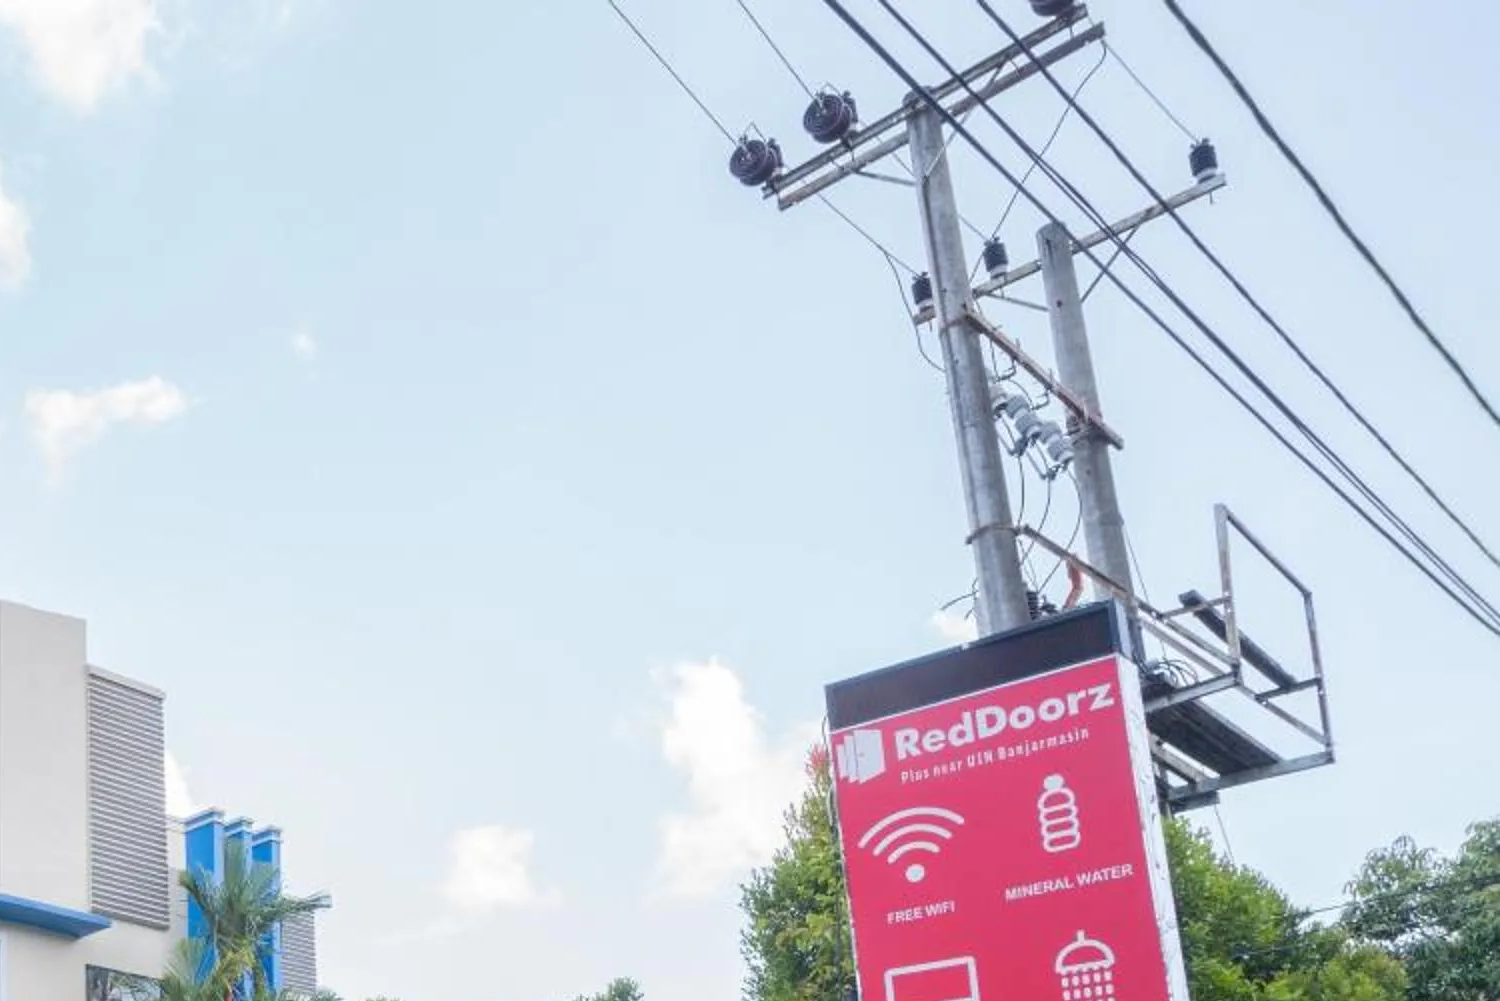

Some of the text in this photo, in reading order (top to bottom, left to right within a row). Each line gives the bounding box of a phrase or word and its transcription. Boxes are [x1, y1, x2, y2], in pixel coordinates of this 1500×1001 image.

[894, 683, 1115, 761] RedDoorz
[900, 767, 929, 784] Plus
[933, 759, 963, 776] near
[998, 727, 1089, 760] Banjarmasin
[1004, 863, 1134, 902] MINERAL WATER
[886, 899, 956, 925] FREE WIFI
